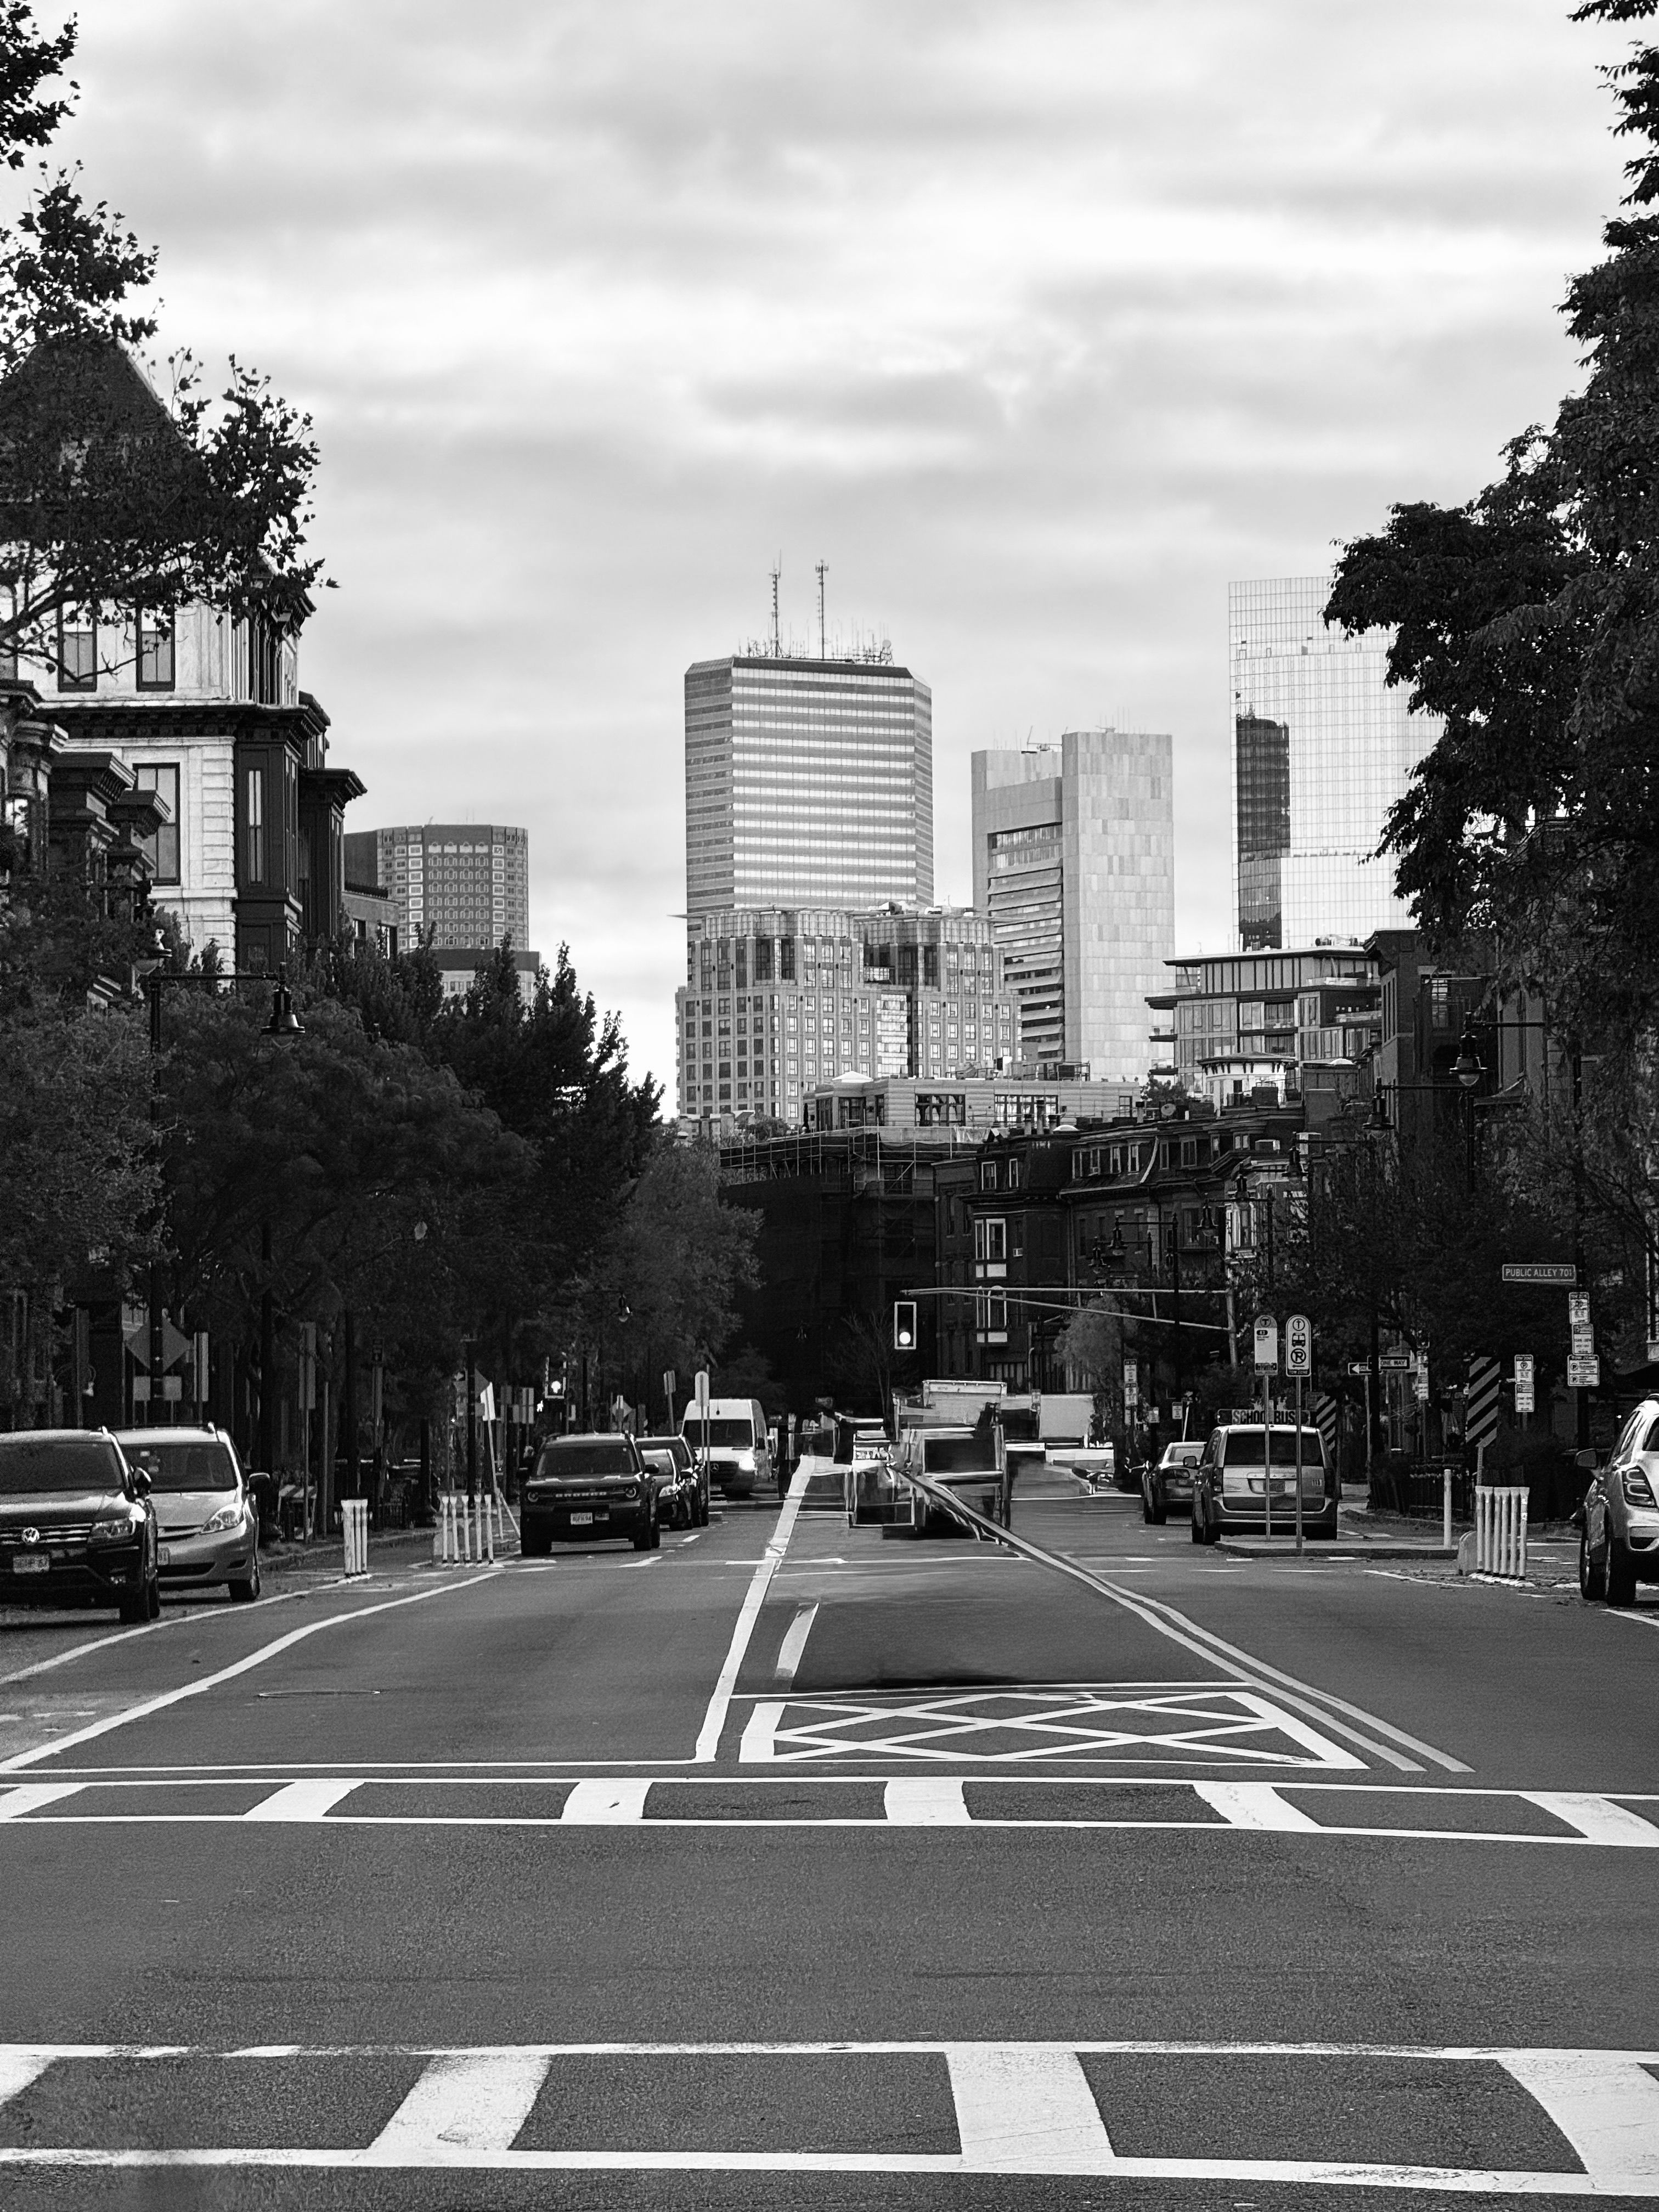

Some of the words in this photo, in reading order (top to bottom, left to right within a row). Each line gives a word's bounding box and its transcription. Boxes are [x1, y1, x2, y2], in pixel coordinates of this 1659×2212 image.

[1505, 1268, 1532, 1277] PUBLIC
[1533, 1268, 1557, 1277] ALLEY
[1559, 1268, 1572, 1277] 701
[1274, 1410, 1296, 1424] BUS
